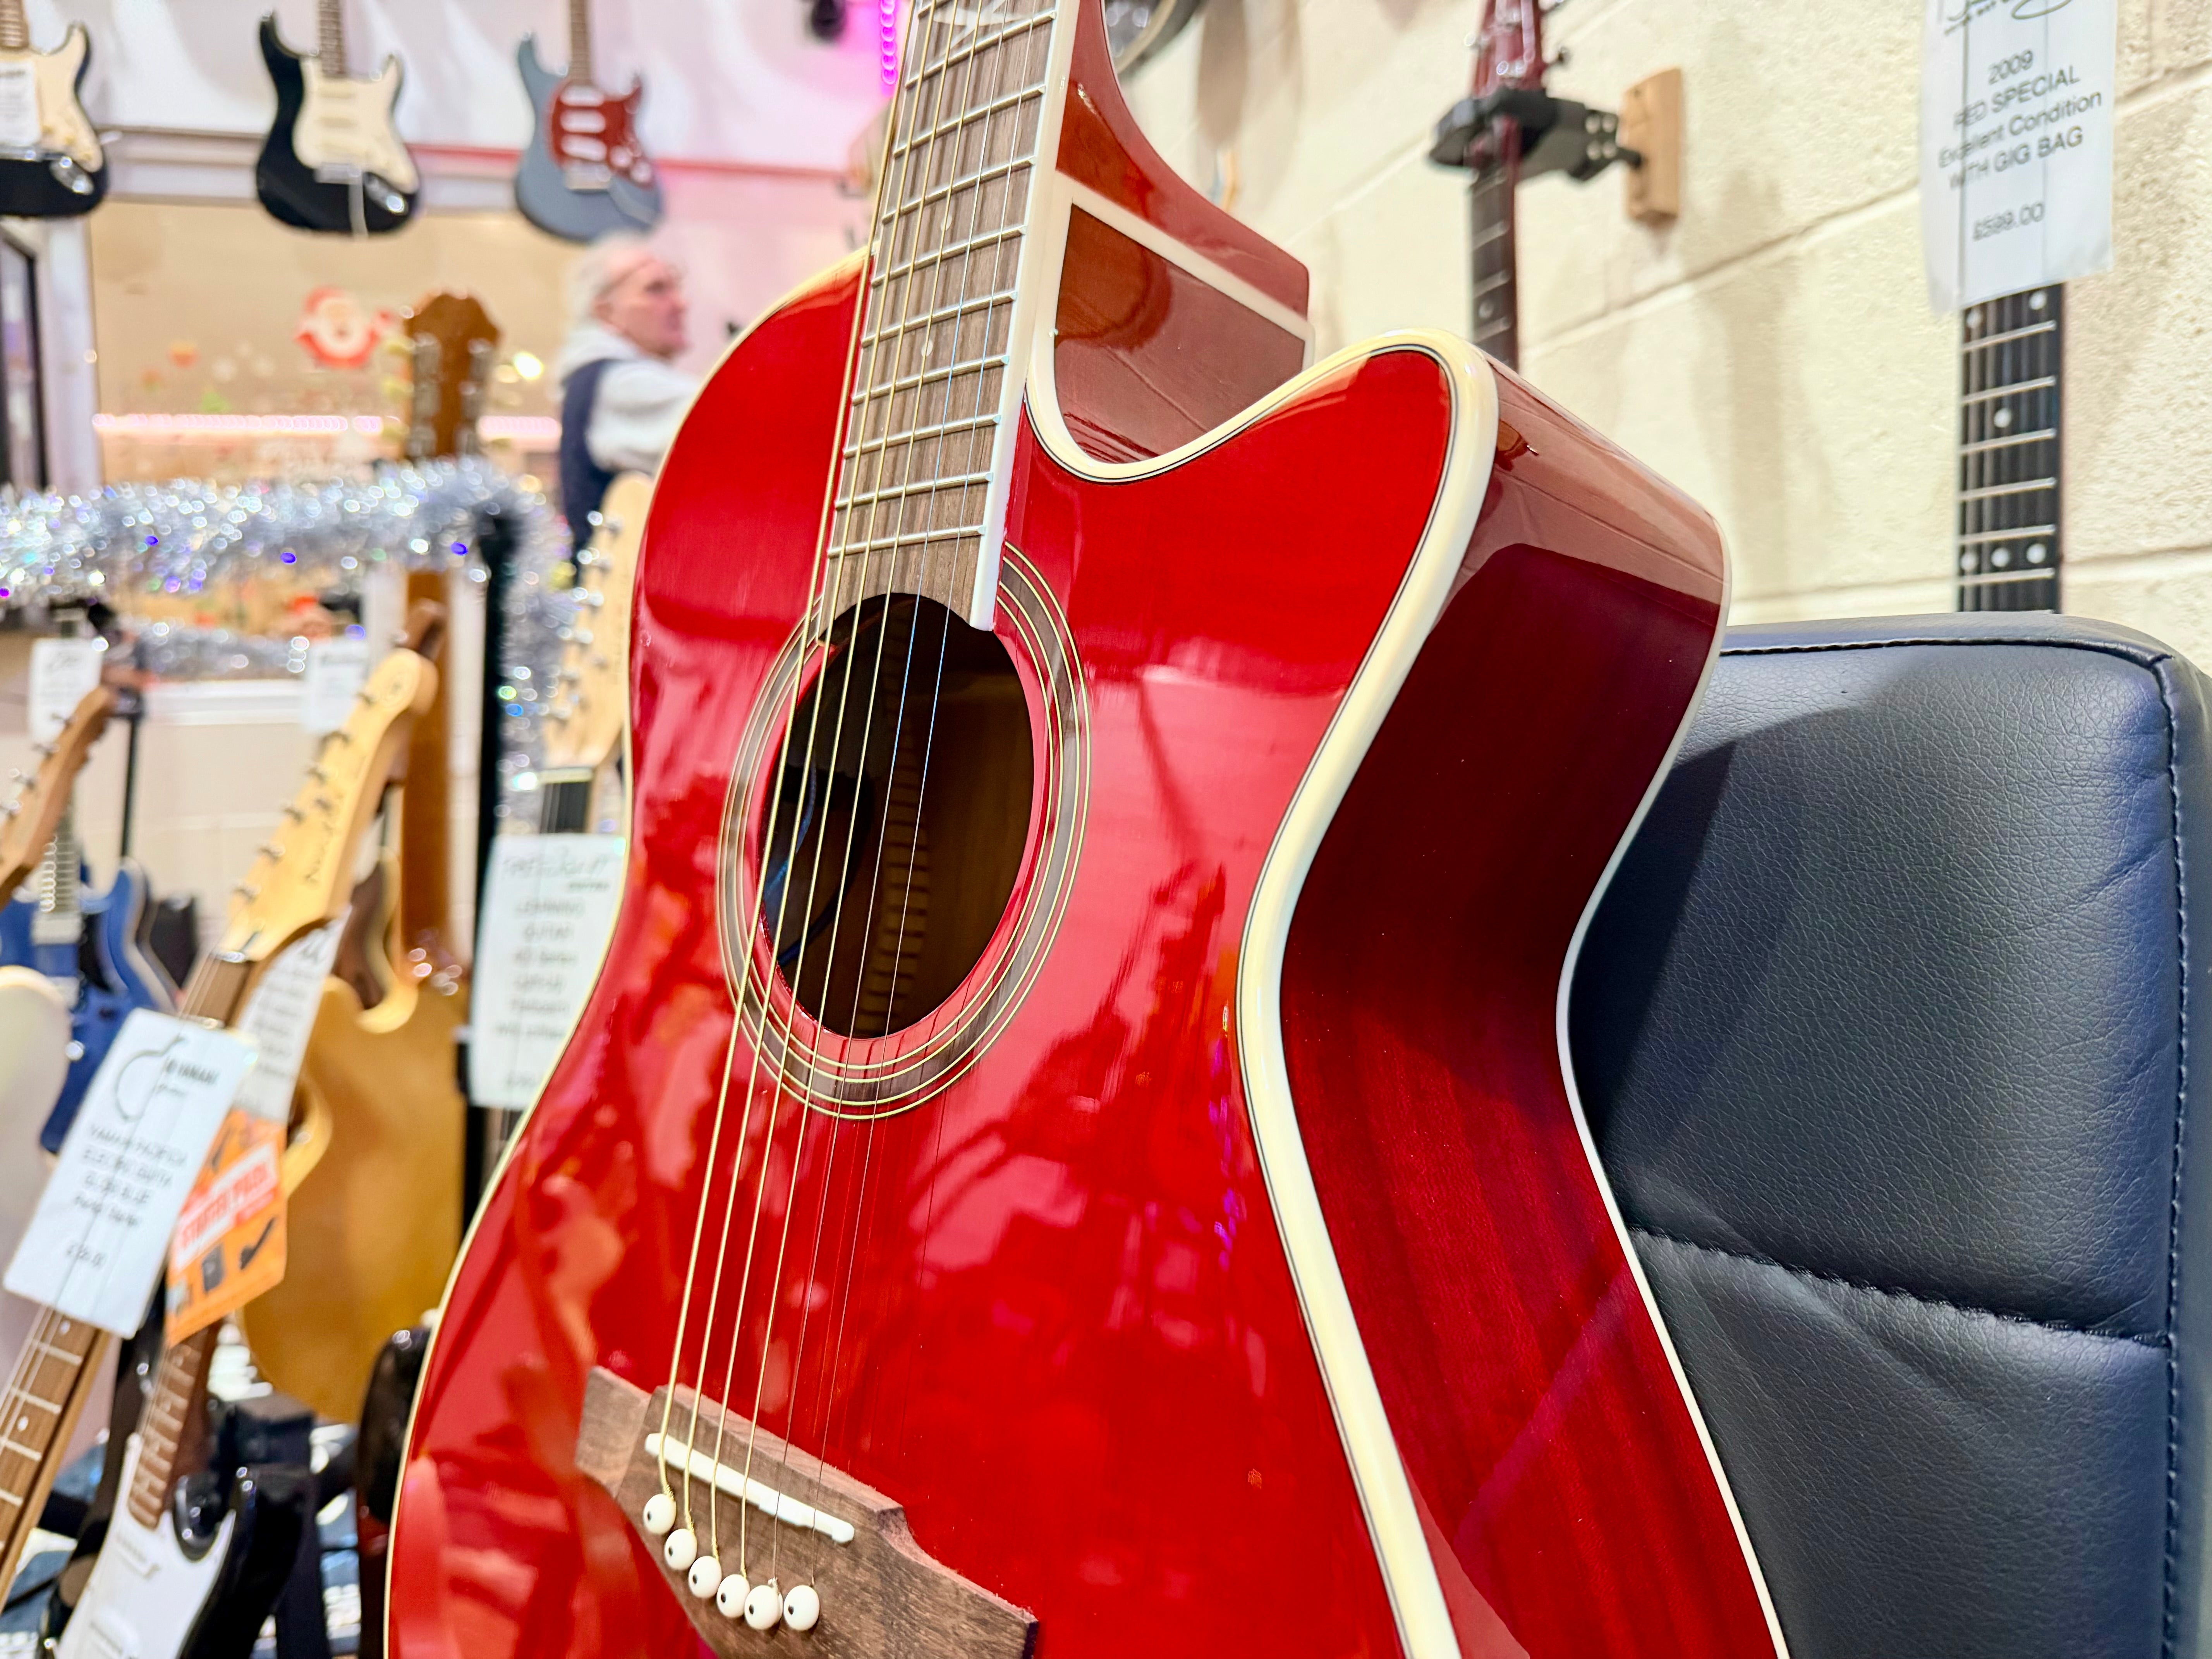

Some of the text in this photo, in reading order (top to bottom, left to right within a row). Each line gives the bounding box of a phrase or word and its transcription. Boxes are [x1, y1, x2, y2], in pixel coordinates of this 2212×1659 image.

[1988, 49, 2033, 85] 2009
[1992, 64, 2081, 113] SPECIAL
[2008, 91, 2102, 136] Condition
[1994, 143, 2030, 172] GIG
[2037, 125, 2083, 158] BAG
